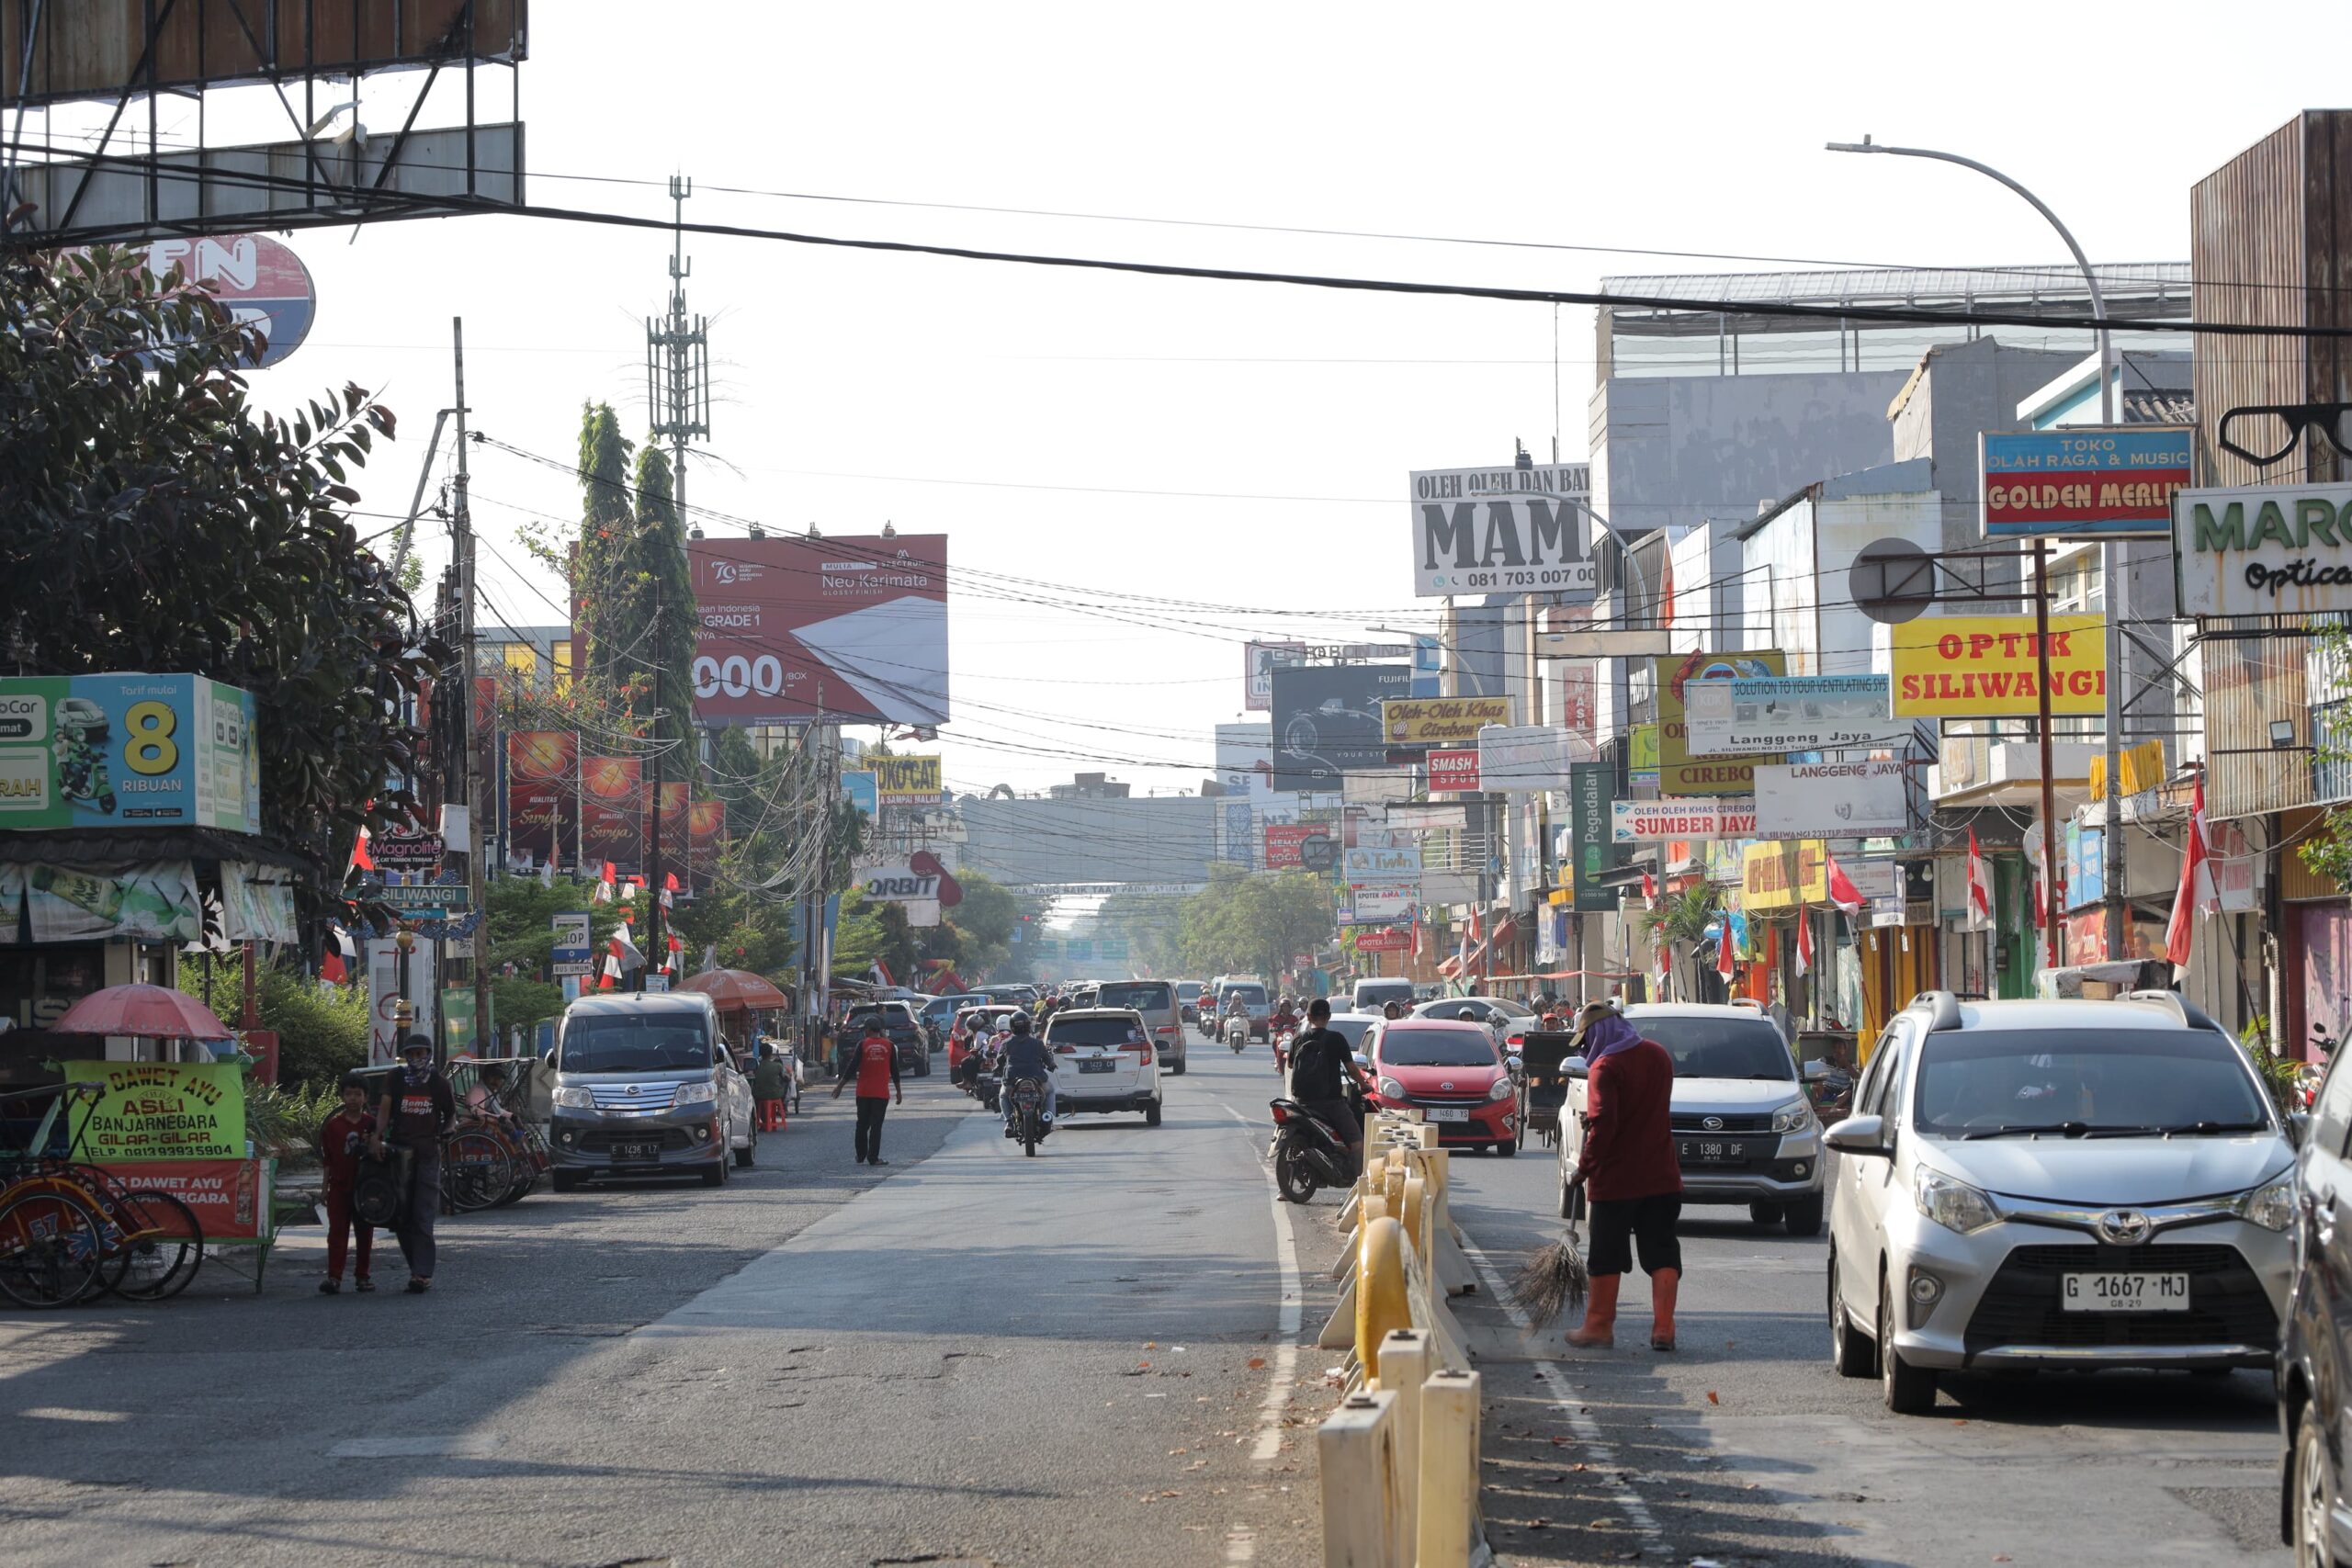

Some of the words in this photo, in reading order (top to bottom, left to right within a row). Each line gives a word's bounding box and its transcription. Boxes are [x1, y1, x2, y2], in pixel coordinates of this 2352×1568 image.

[2061, 439, 2116, 452] TOKO
[1987, 455, 2039, 468] OLAH
[2046, 453, 2099, 467] RAGA
[2108, 454, 2120, 466] &
[2131, 452, 2188, 465] MUSIC
[1418, 475, 1463, 499] OLEH
[1468, 472, 1513, 497] OLEH
[1520, 469, 1554, 494] DAN
[1987, 484, 2091, 510] GOLDEN
[822, 576, 854, 589] Neo
[859, 573, 928, 588] Karimata
[1467, 573, 1498, 587] 081
[1505, 571, 1535, 585] 703
[1541, 570, 1571, 583] 007
[718, 604, 761, 613] Indonesia
[705, 615, 752, 626] GRADE
[754, 614, 761, 626] 1
[1939, 632, 2071, 660] OPTIK
[121, 685, 144, 695] Tarif
[147, 683, 176, 694] mulai
[1735, 683, 1777, 701] SOLUTION
[1778, 682, 1791, 698] TO
[1792, 682, 1817, 698] YOUR
[1817, 679, 1870, 697] VENTILATING
[1388, 704, 1464, 720] Oleh-Oleh
[1465, 702, 1505, 717] Khas
[1419, 722, 1475, 737] Cirebon
[124, 700, 178, 776] 8
[1730, 734, 1818, 747] Langgeng
[1829, 730, 1872, 743] Jaya
[1861, 738, 1894, 746] CIREBON
[1431, 757, 1473, 772] SMASH
[1791, 764, 1867, 779] LANGGENG
[1872, 762, 1904, 775] JAYA
[909, 760, 938, 790] CAT
[122, 779, 183, 793] RIBUAN
[529, 795, 558, 804] KUALITAS
[887, 795, 913, 804] SAMPAI
[914, 794, 941, 804] MALAM
[1583, 768, 1601, 843] Pegadaian
[1634, 807, 1659, 816] OLEH
[1662, 807, 1686, 815] OLEH
[1689, 806, 1713, 814] KHAS
[520, 809, 569, 830] Surya
[590, 825, 634, 843] Surya
[1770, 829, 1811, 839] SILIWANGI
[1812, 829, 1826, 838] 233
[372, 842, 440, 858] Magnolite
[867, 876, 936, 896] ORBIT
[381, 889, 457, 901] SILIWANGI
[1360, 938, 1383, 946] APOTEK
[570, 964, 589, 973] UMUM
[109, 1067, 179, 1092] DAWET
[184, 1077, 222, 1106] AYU
[122, 1099, 185, 1116] ASLI
[93, 1114, 218, 1132] BANJARNEGARA
[613, 1145, 617, 1155] E
[1682, 1145, 1689, 1155] E
[1701, 1144, 1722, 1155] 1380
[1731, 1144, 1743, 1155] DF
[130, 1178, 188, 1188] DAWET
[191, 1179, 222, 1189] AYU
[2066, 1277, 2079, 1297] G
[2097, 1276, 2145, 1296] 1667
[2161, 1276, 2186, 1296] MJ
